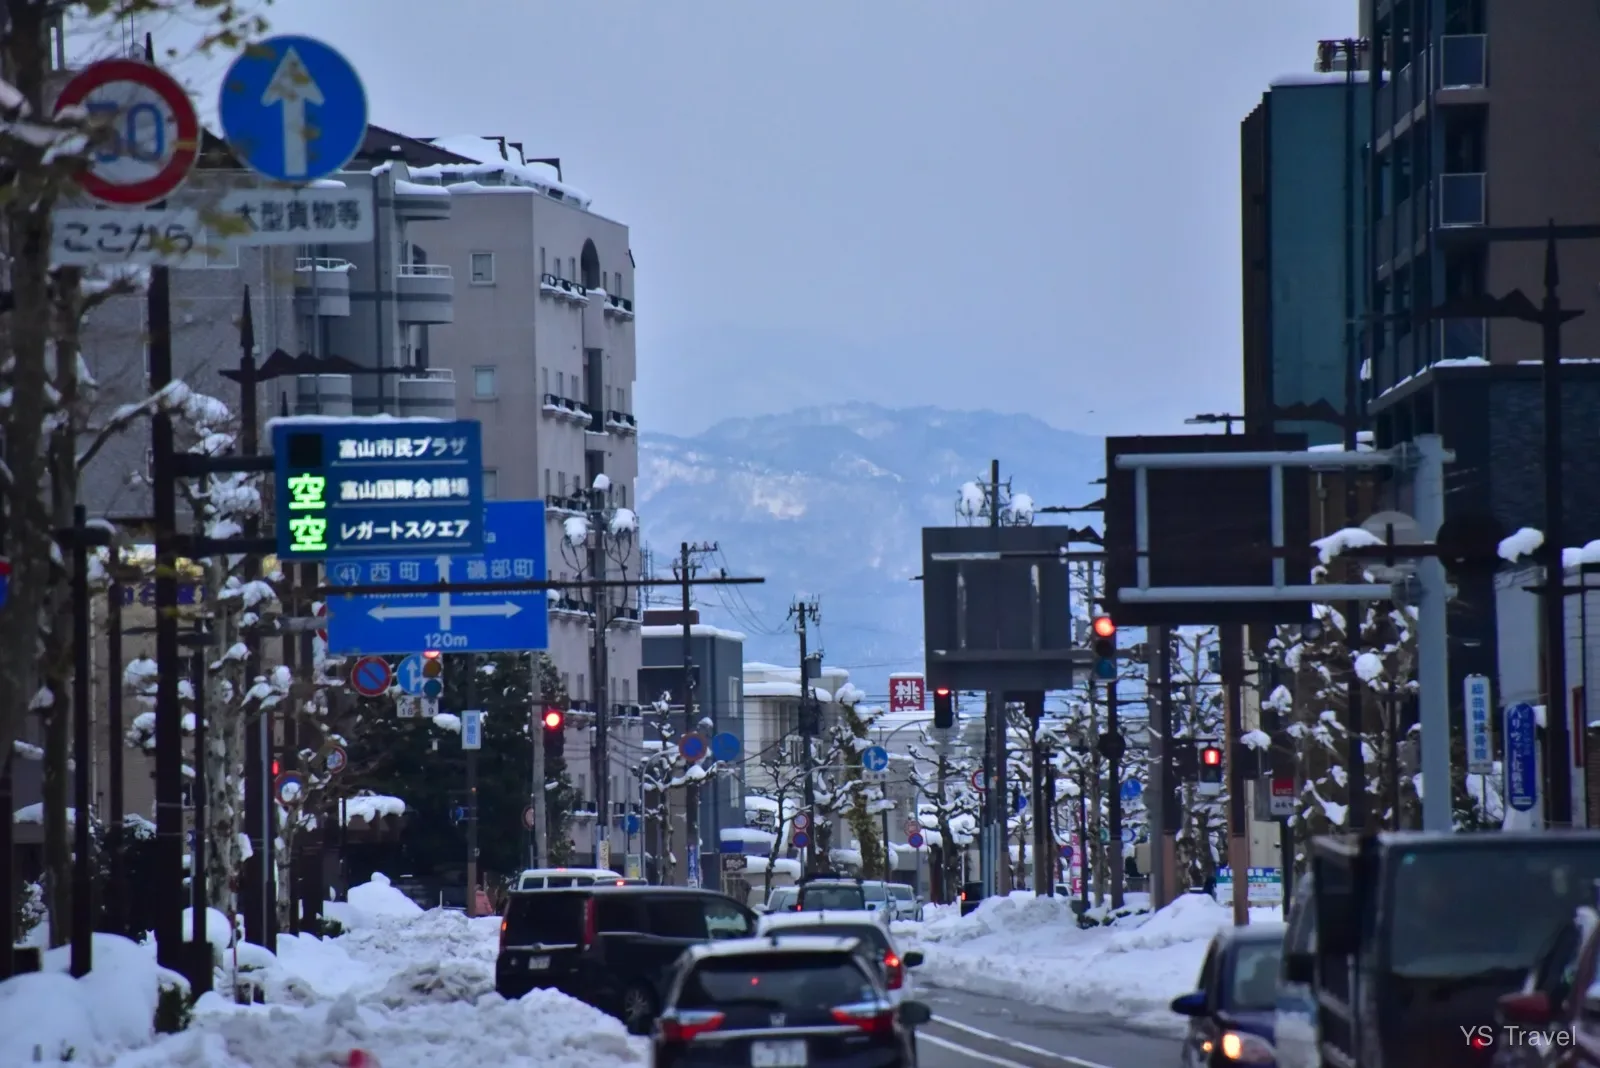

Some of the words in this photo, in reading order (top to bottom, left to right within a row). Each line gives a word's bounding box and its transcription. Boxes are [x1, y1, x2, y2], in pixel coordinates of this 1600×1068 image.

[235, 199, 362, 232] 大型貨物等
[63, 221, 194, 254] ここから
[339, 436, 468, 459] 富山市民プラザ
[287, 473, 326, 510] 空
[340, 477, 469, 500] 富山国際会議場
[289, 515, 327, 551] 空
[340, 519, 470, 540] レガートスクエア
[340, 567, 357, 582] 41
[370, 562, 421, 582] 西町
[424, 633, 468, 648] 120m
